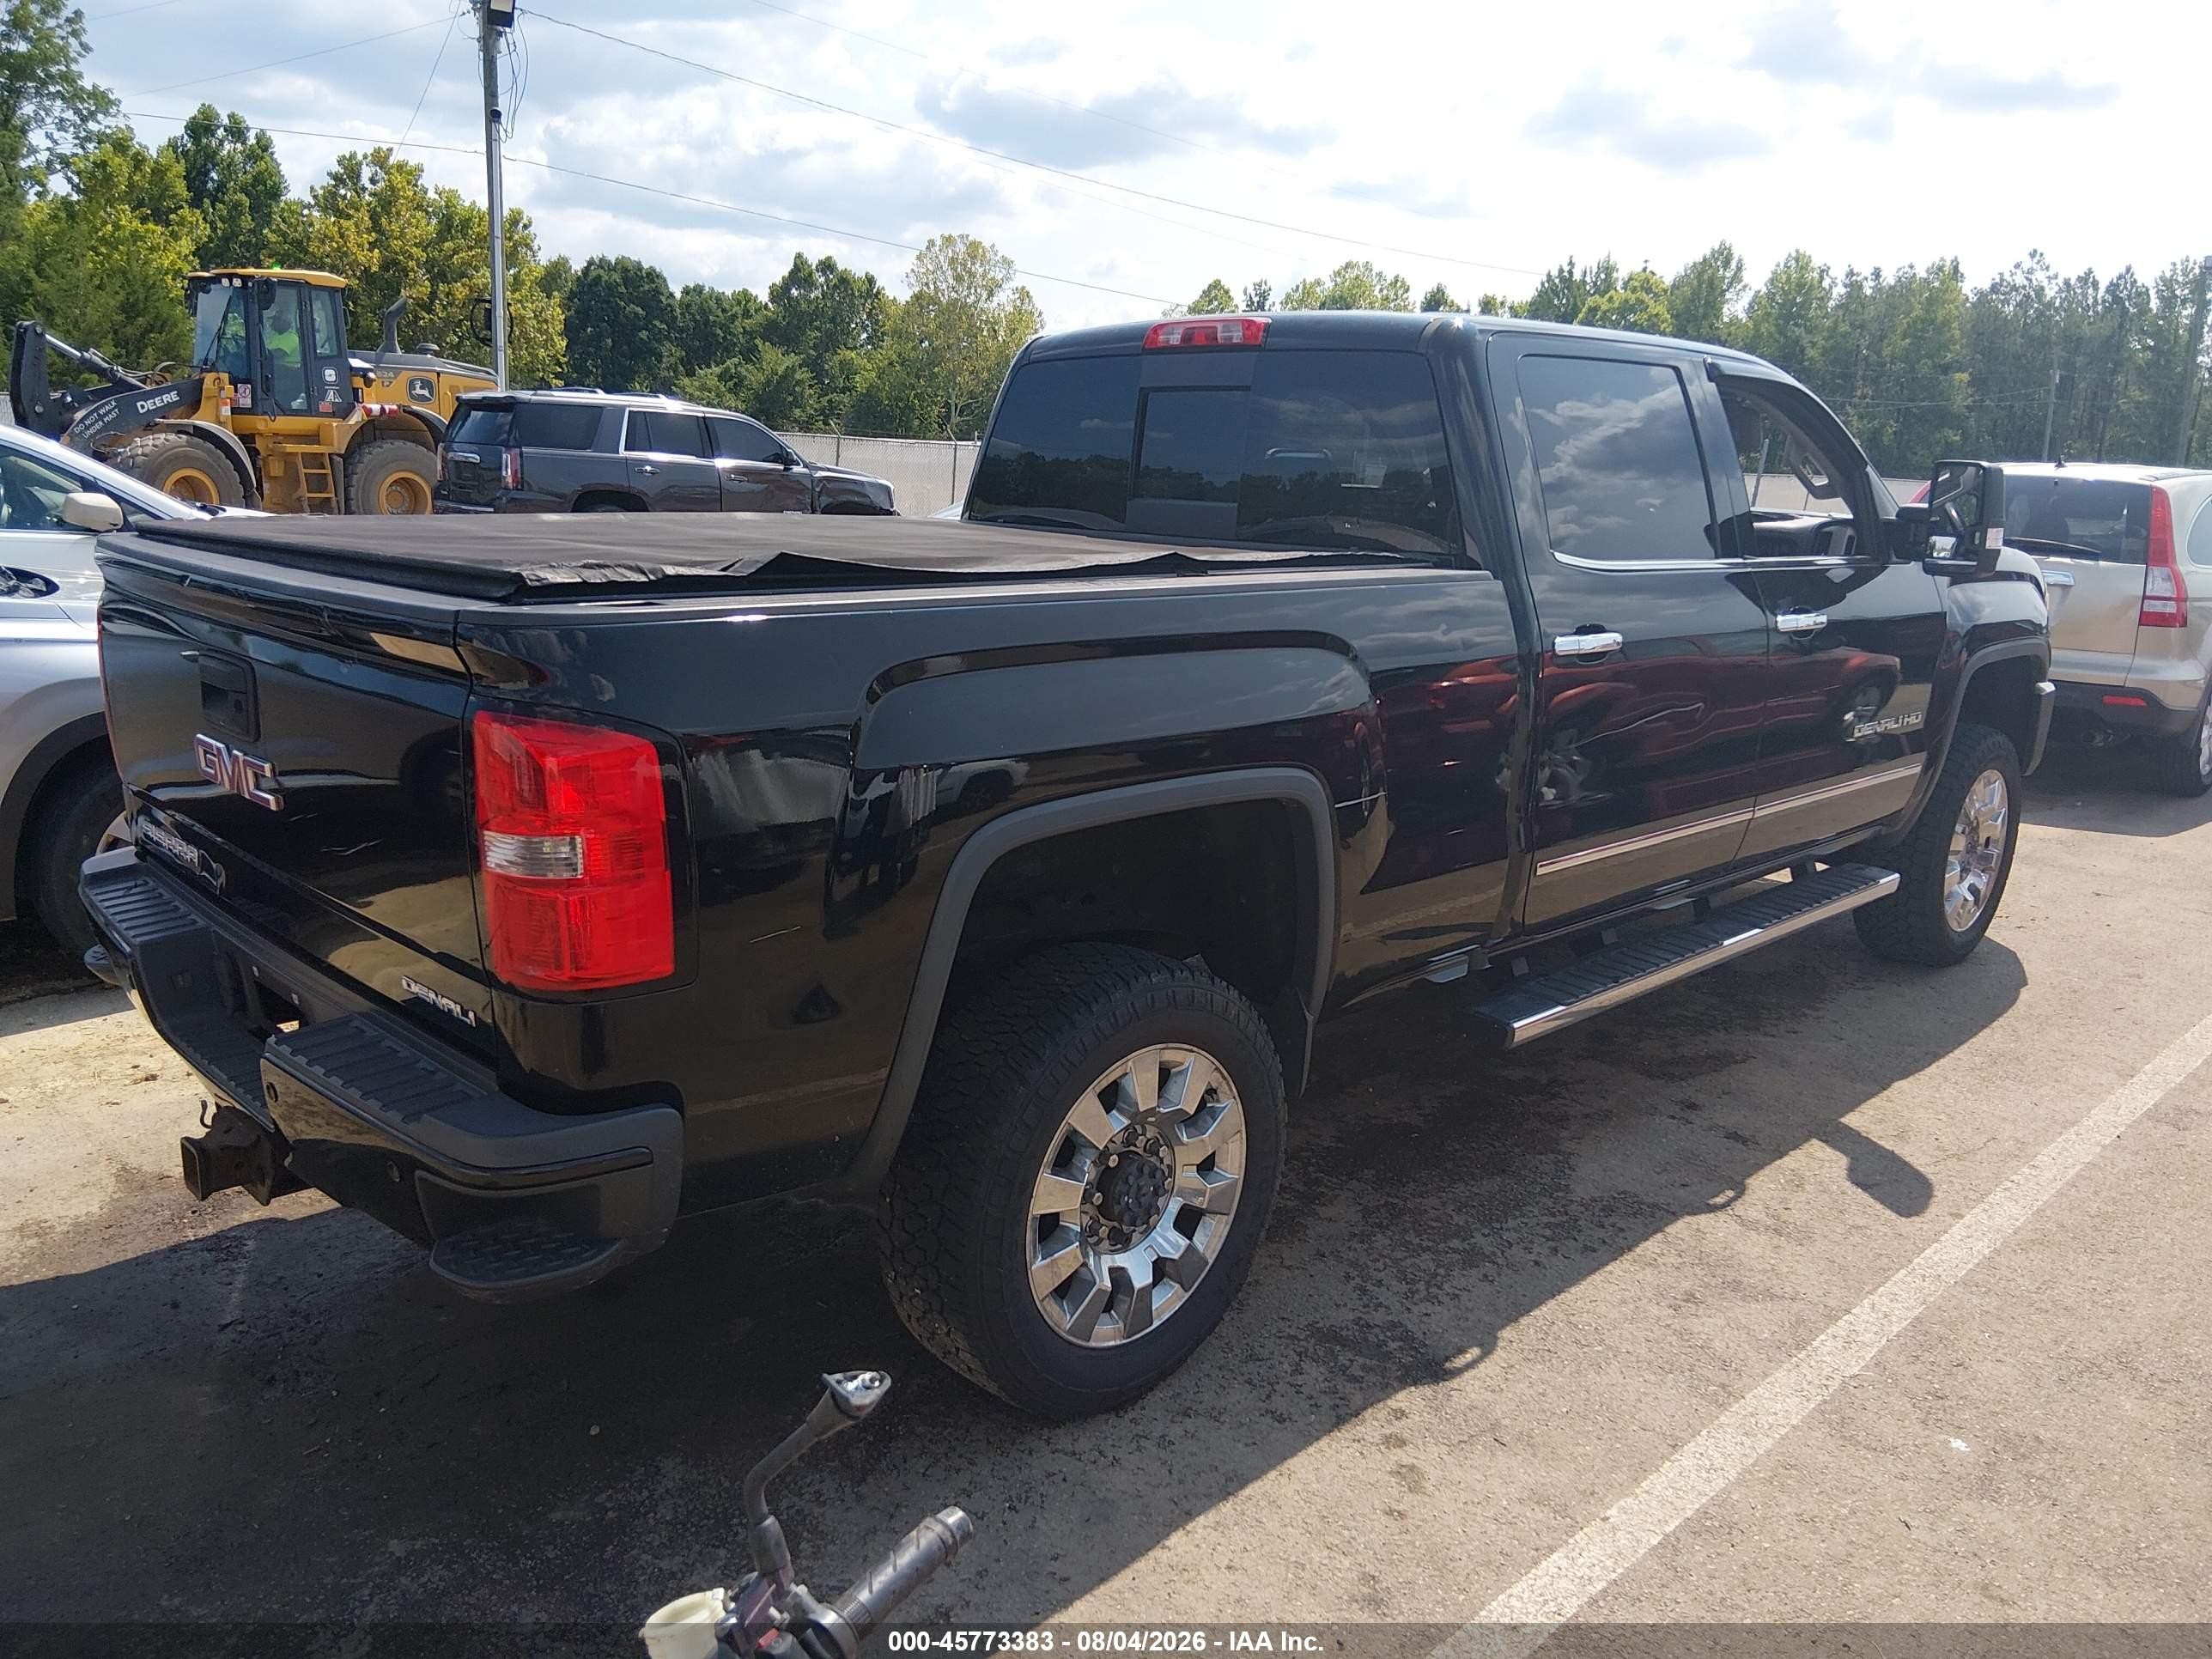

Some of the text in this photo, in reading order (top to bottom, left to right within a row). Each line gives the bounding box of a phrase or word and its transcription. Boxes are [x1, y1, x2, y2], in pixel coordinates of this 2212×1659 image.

[74, 398, 118, 434] DO NOT WALK
[137, 391, 180, 413] DEERE
[82, 408, 120, 439] UNDER MAST
[193, 733, 284, 811] GMC
[140, 823, 198, 867] SIERRA
[400, 975, 477, 1028] DENALI
